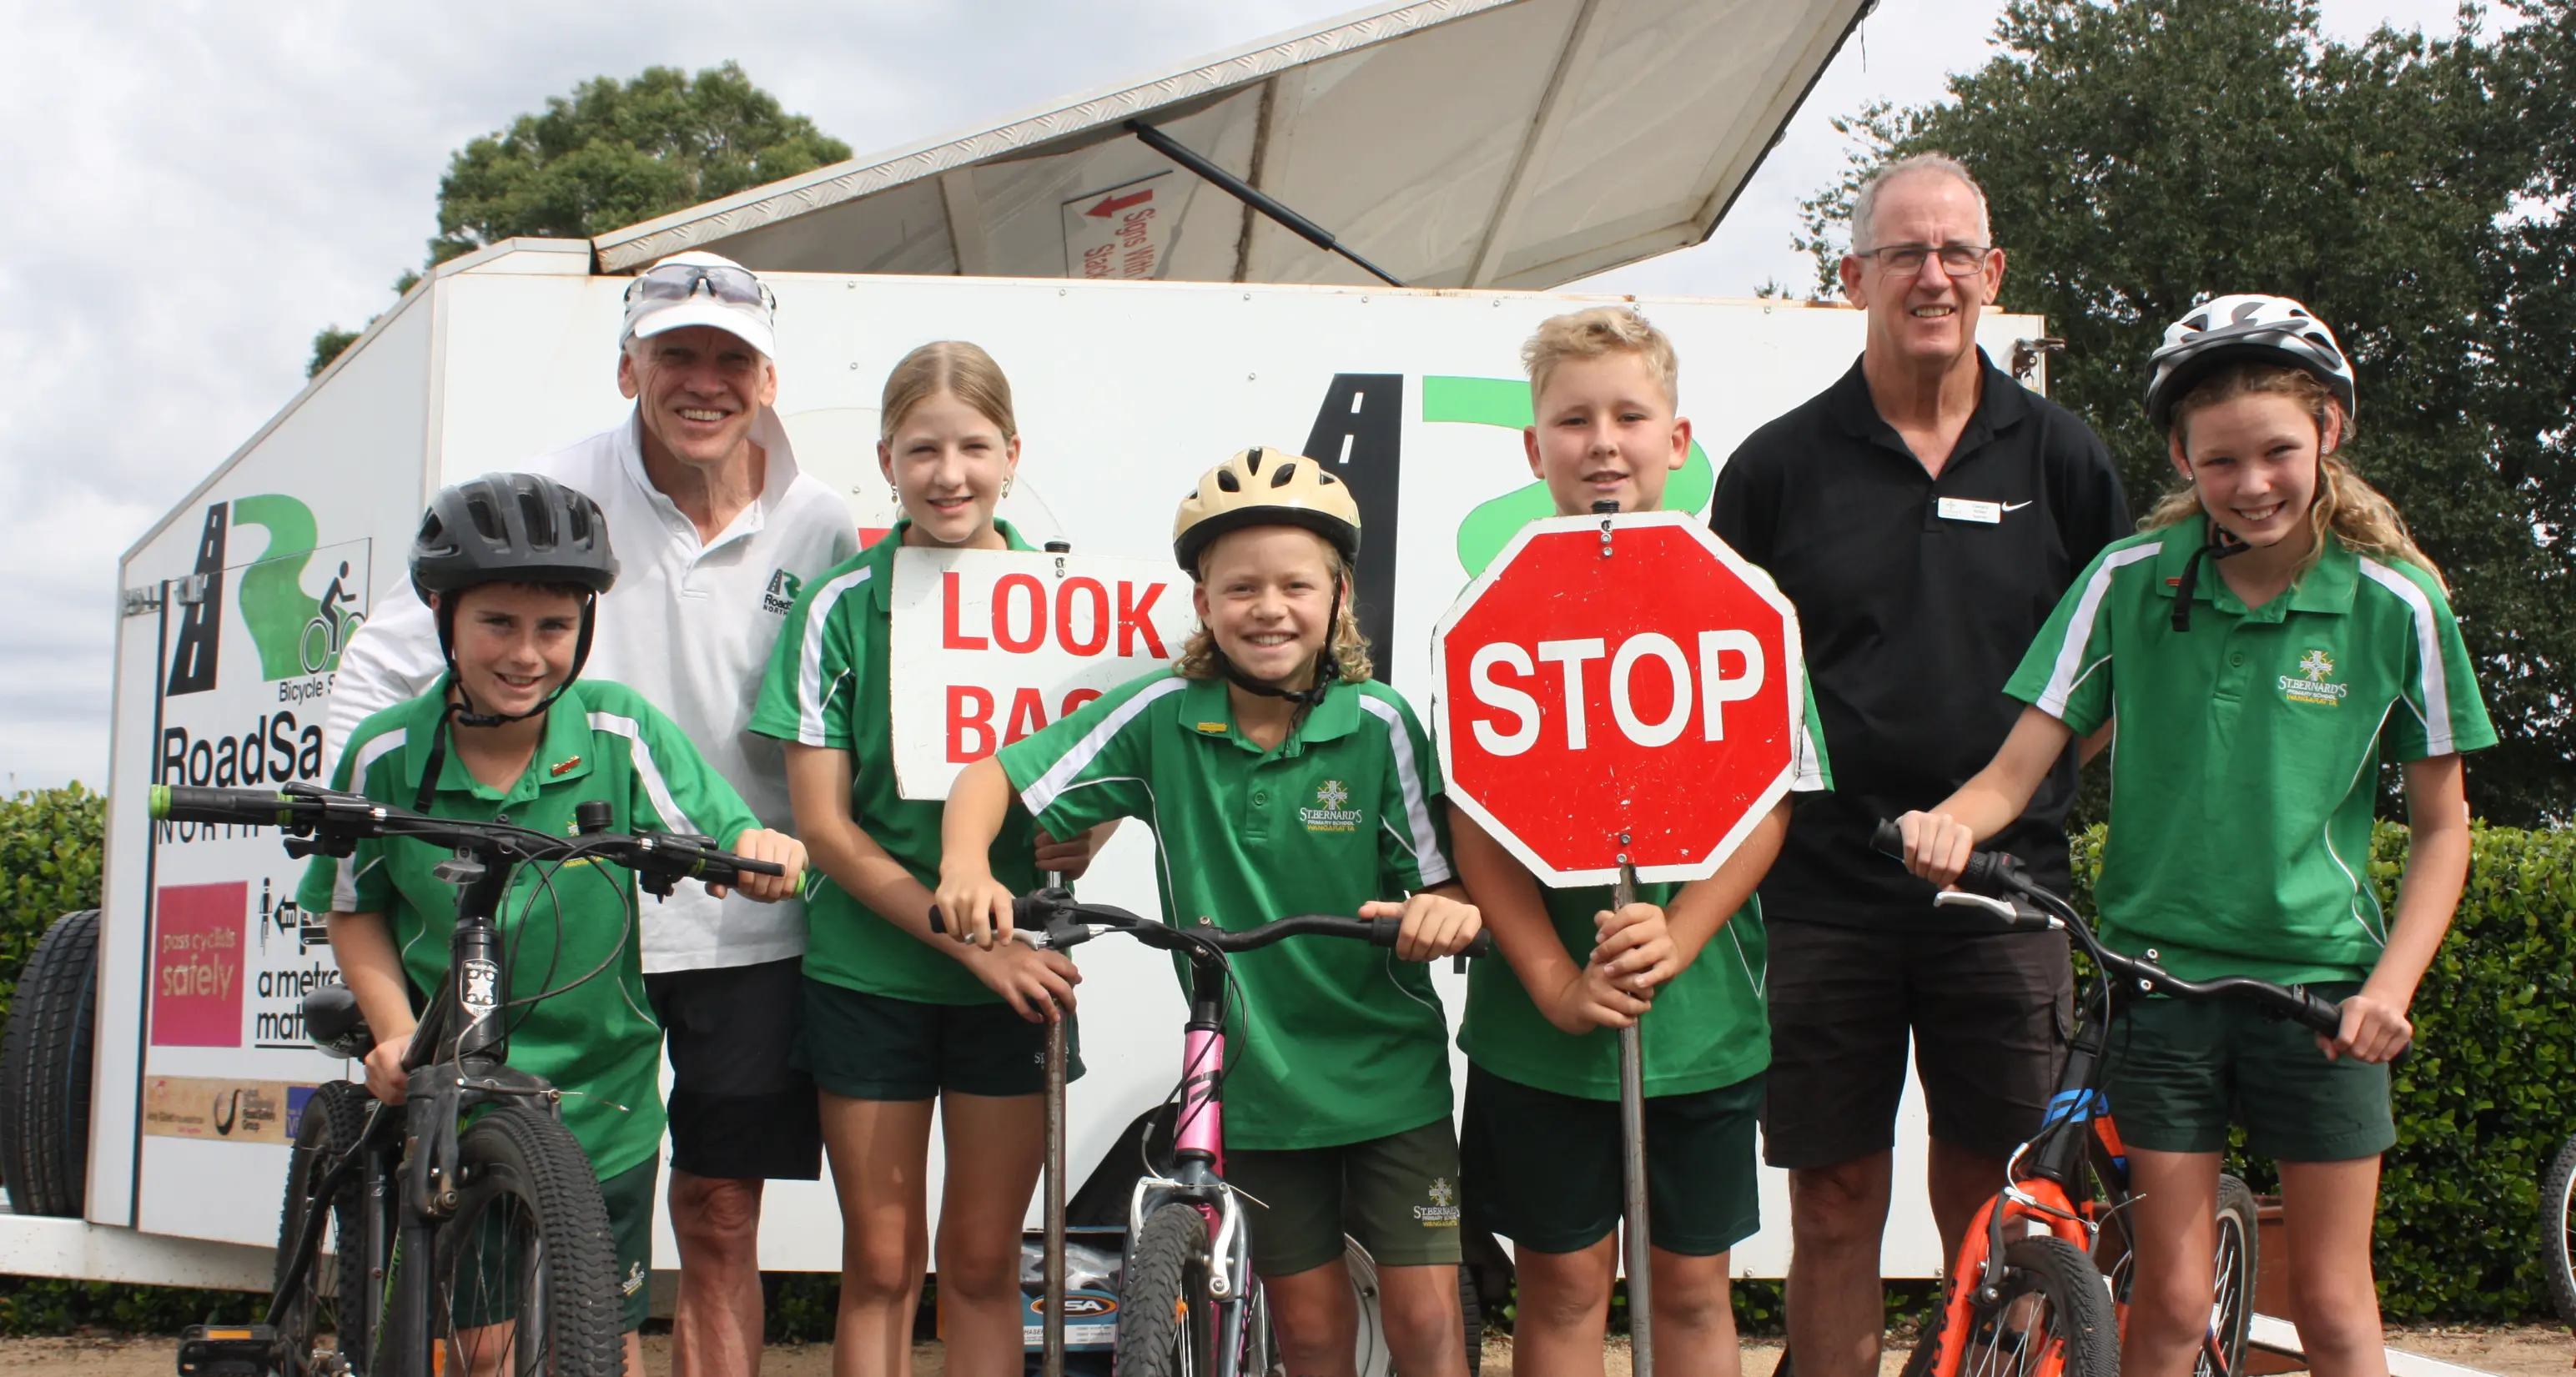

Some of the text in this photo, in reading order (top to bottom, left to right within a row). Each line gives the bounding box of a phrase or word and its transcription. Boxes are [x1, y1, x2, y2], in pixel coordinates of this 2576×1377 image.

[1114, 208, 1155, 248] Signs
[1124, 244, 1155, 278] With
[943, 571, 1169, 659] LOOK
[279, 677, 324, 706] Bicycle
[1469, 629, 1765, 757] STOP
[279, 906, 295, 924] 1m
[163, 933, 189, 954] pass
[162, 952, 236, 1002] safely
[257, 970, 273, 998] a
[1064, 1299, 1104, 1312] SA
